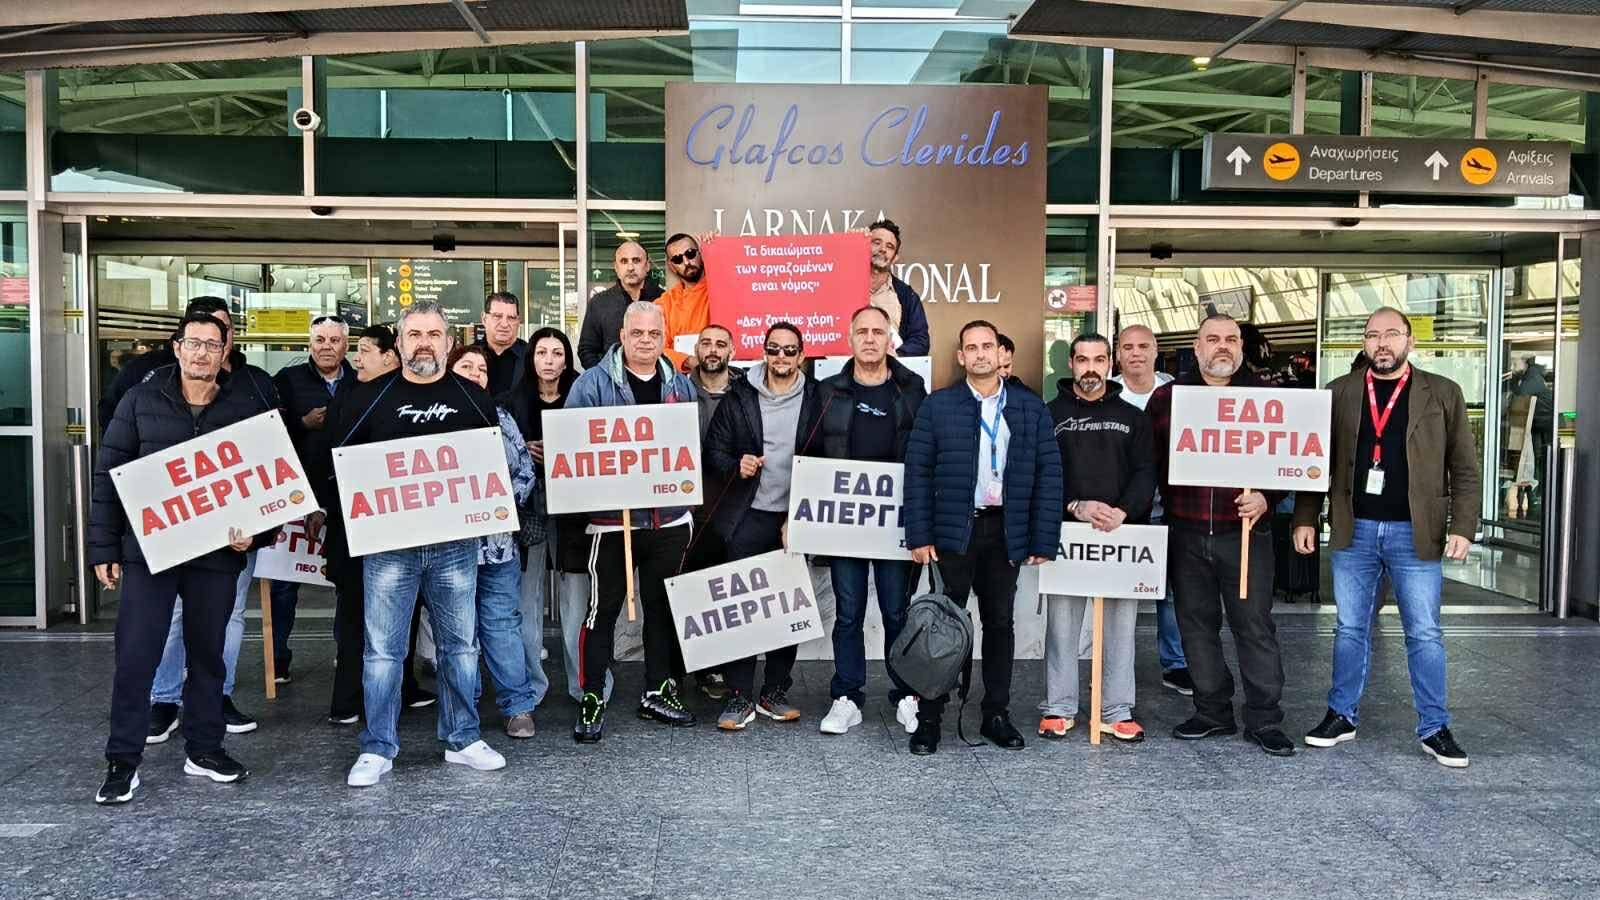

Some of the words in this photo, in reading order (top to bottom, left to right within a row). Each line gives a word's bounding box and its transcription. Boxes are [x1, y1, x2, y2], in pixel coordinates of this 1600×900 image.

[686, 104, 845, 183] Glafcos
[861, 104, 1030, 168] Clerides
[1310, 145, 1399, 163] Αναχωρήσεις
[1507, 150, 1554, 167] Αφίξεις
[1309, 167, 1383, 183] Departures
[1506, 172, 1554, 185] Arrivals
[713, 208, 888, 238] LARNAK
[744, 245, 758, 256] Τα
[760, 243, 823, 259] δικαιώματα
[736, 264, 757, 274] των
[760, 260, 834, 276] εργαζομένων
[752, 282, 778, 291] ειναι
[807, 312, 833, 327] χάρη
[802, 330, 842, 345] όμιμα»
[1217, 398, 1284, 424] ΕΔΩ
[588, 416, 654, 444] ΕΔΩ
[1175, 428, 1324, 457] ΑΠΕΡΓΙΑ
[165, 440, 243, 487] ΕΔΩ
[385, 445, 459, 479] ΕΔΩ
[551, 446, 695, 479] ΑΠΕΡΓΙΑ
[1278, 467, 1303, 478] ΠΕΟ
[653, 483, 678, 494] ΠΕΟ
[833, 470, 894, 497] ΕΔΩ
[141, 456, 299, 536] ΑΠΕΡΓΙΑ
[350, 472, 508, 519] ΑΠΕΡΓΙΑ
[259, 498, 287, 516] ΠΕΟ
[794, 498, 905, 528] ΑΠΕΡΓΙ
[464, 511, 491, 524] ΠΕΟ
[1057, 542, 1154, 564] ΑΠΕΡΓΙΑ
[295, 562, 318, 574] ΠΕΟ
[708, 567, 769, 602] ΕΔΩ
[684, 587, 812, 640] ΑΠΕΡΓΙΑ
[790, 620, 812, 633] ΣΕΚ
